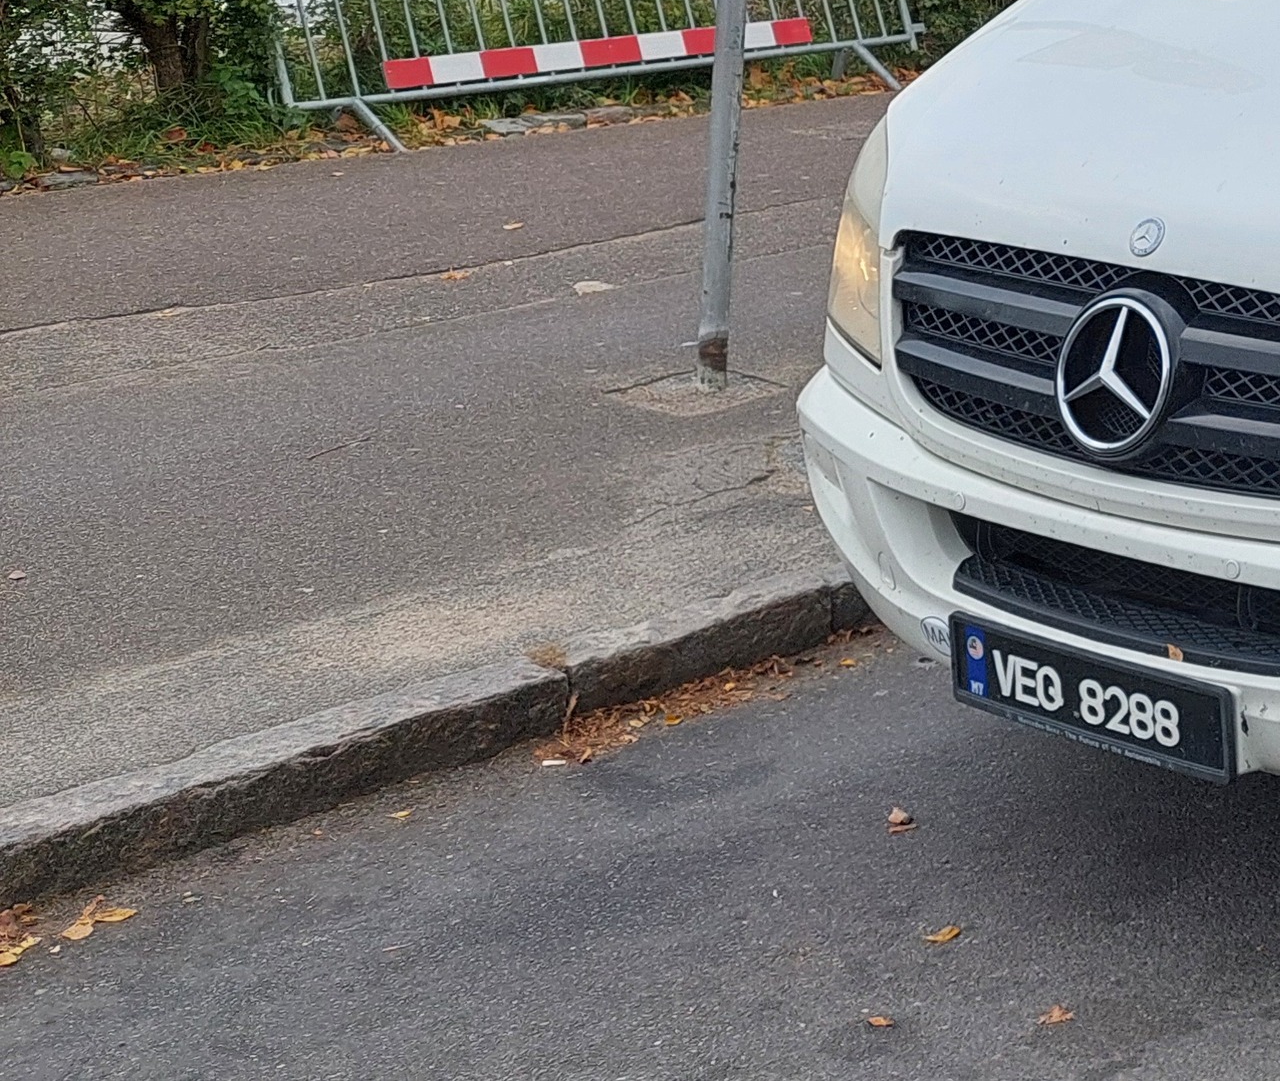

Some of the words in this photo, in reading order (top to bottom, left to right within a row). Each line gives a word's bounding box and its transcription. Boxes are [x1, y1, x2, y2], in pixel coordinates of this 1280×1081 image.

[923, 623, 951, 648] MA
[992, 649, 1064, 712] VEQ
[1078, 679, 1180, 747] 8288
